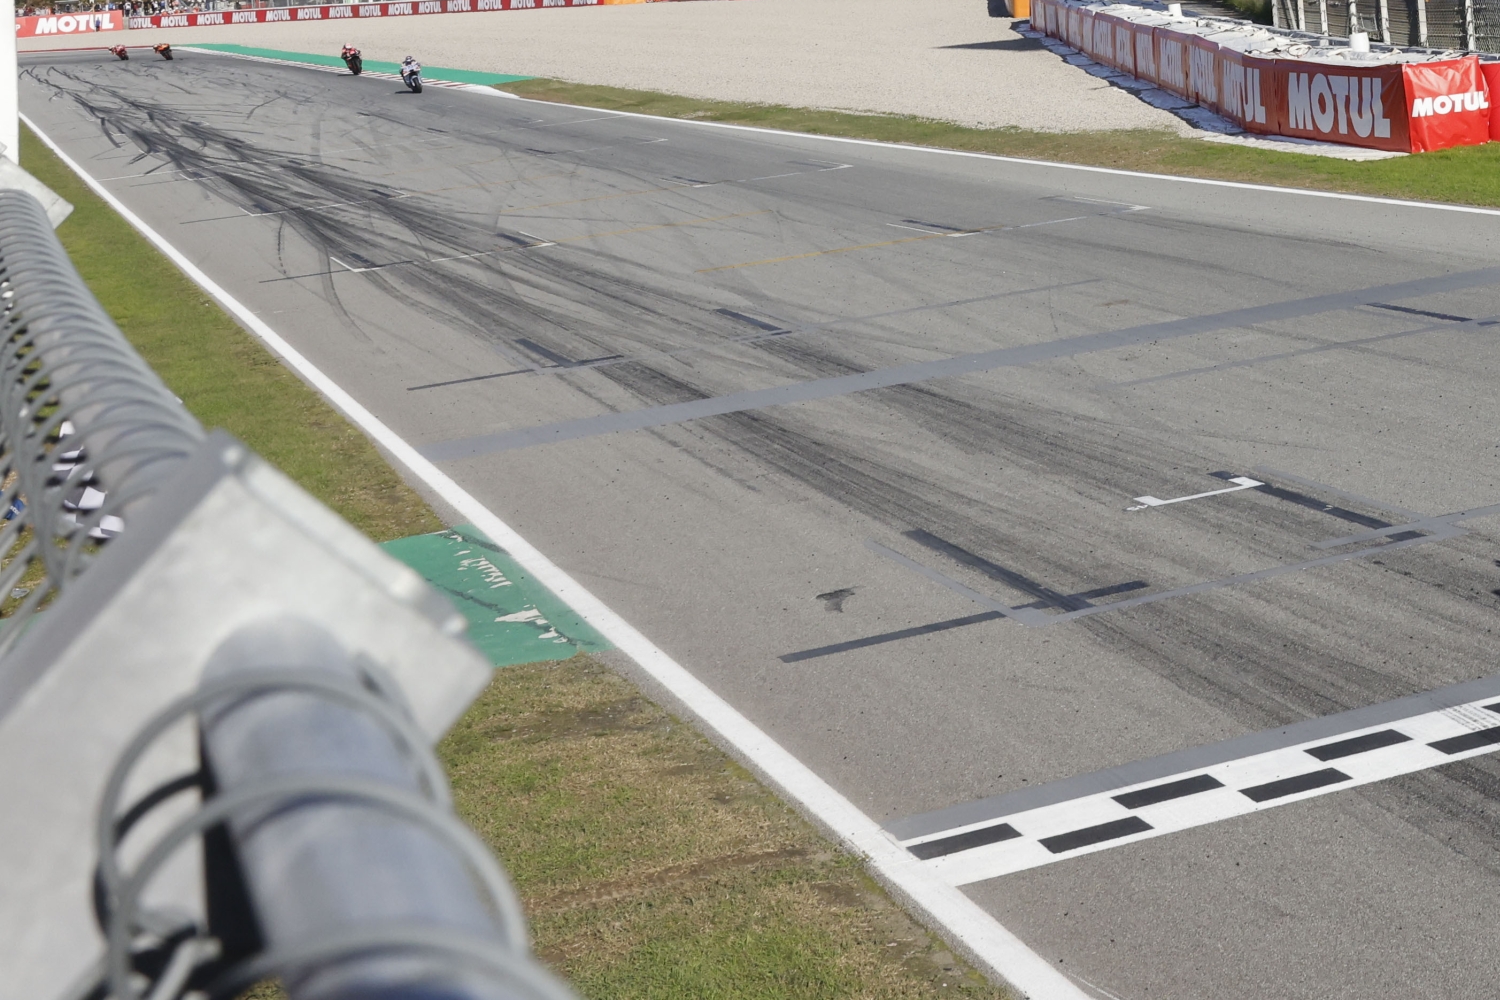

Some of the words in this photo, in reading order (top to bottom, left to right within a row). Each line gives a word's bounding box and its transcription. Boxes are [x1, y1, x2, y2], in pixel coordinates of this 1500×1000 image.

[329, 5, 352, 18] MOTUL
[359, 4, 382, 17] MOTUL
[387, 2, 412, 15] MOTUL
[418, 1, 442, 14] MOTUL
[447, 0, 471, 12] MOTUL
[197, 12, 225, 25] MOTUL
[232, 10, 258, 24] MOTUL
[266, 8, 291, 21] MOTUL
[297, 6, 322, 20] MOTUL
[35, 16, 114, 34] MOTUL
[161, 15, 188, 27] MOTUL
[1288, 72, 1391, 139] MOTUL
[1412, 91, 1489, 118] MOTUL
